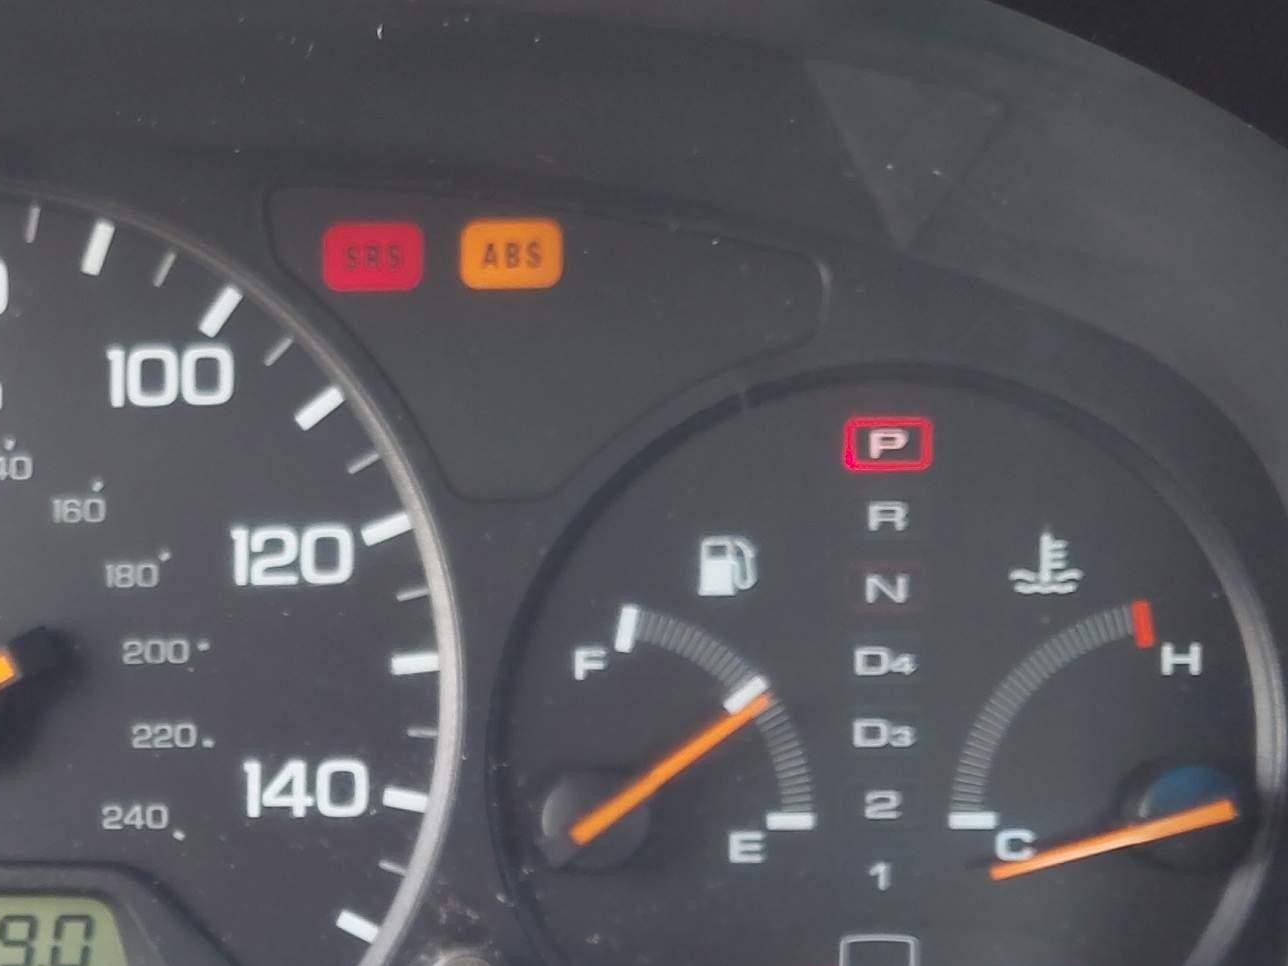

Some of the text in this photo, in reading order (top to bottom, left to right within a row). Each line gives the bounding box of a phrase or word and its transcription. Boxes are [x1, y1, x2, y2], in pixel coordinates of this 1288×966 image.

[345, 244, 402, 271] SRS
[482, 242, 543, 269] ABS
[107, 346, 235, 408] 100
[867, 429, 907, 458] P
[52, 499, 106, 524] 160
[867, 502, 908, 531] R
[231, 525, 354, 586] 120
[105, 564, 159, 588] 180
[865, 576, 910, 603] N
[122, 640, 191, 665] 200
[573, 649, 608, 679] F
[853, 647, 917, 676] D4
[1161, 644, 1202, 676] H
[132, 724, 198, 749] 220
[852, 721, 917, 748] D3
[244, 760, 370, 819] 140
[102, 805, 169, 830] 240
[864, 792, 903, 820] 2
[728, 831, 767, 863] E
[994, 829, 1037, 862] C
[869, 863, 892, 890] 1
